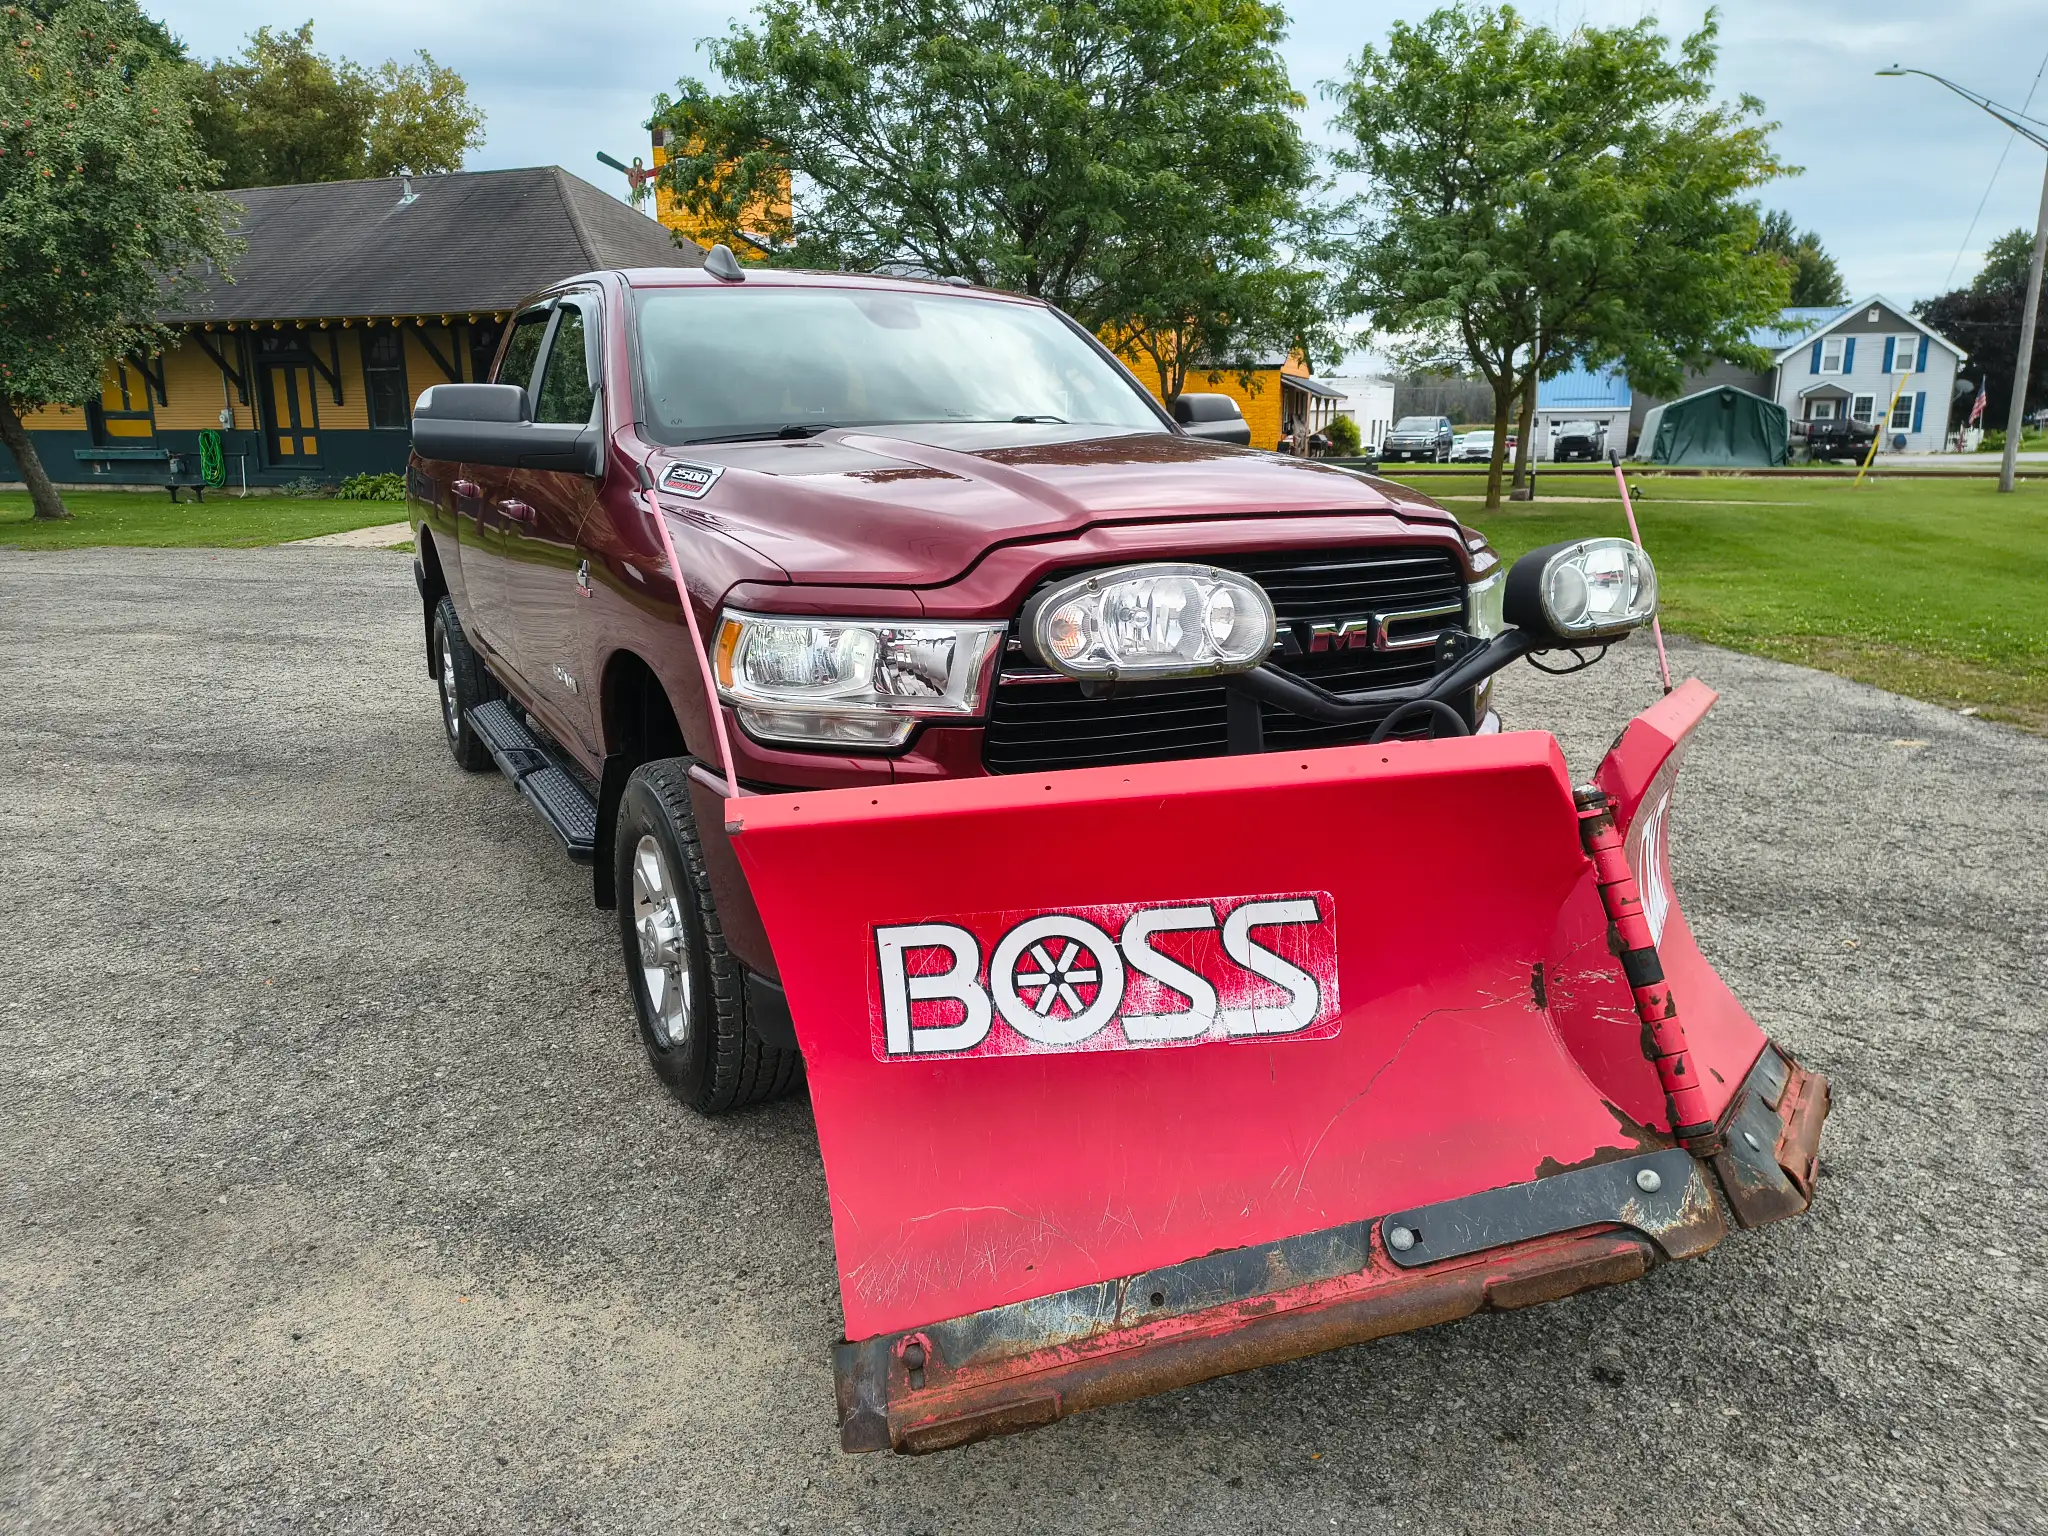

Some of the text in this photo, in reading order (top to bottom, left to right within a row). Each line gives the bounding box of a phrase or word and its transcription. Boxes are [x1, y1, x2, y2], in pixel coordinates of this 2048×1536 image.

[670, 468, 709, 483] 2500
[1273, 620, 1368, 656] AM
[873, 896, 1322, 1056] BOSS
